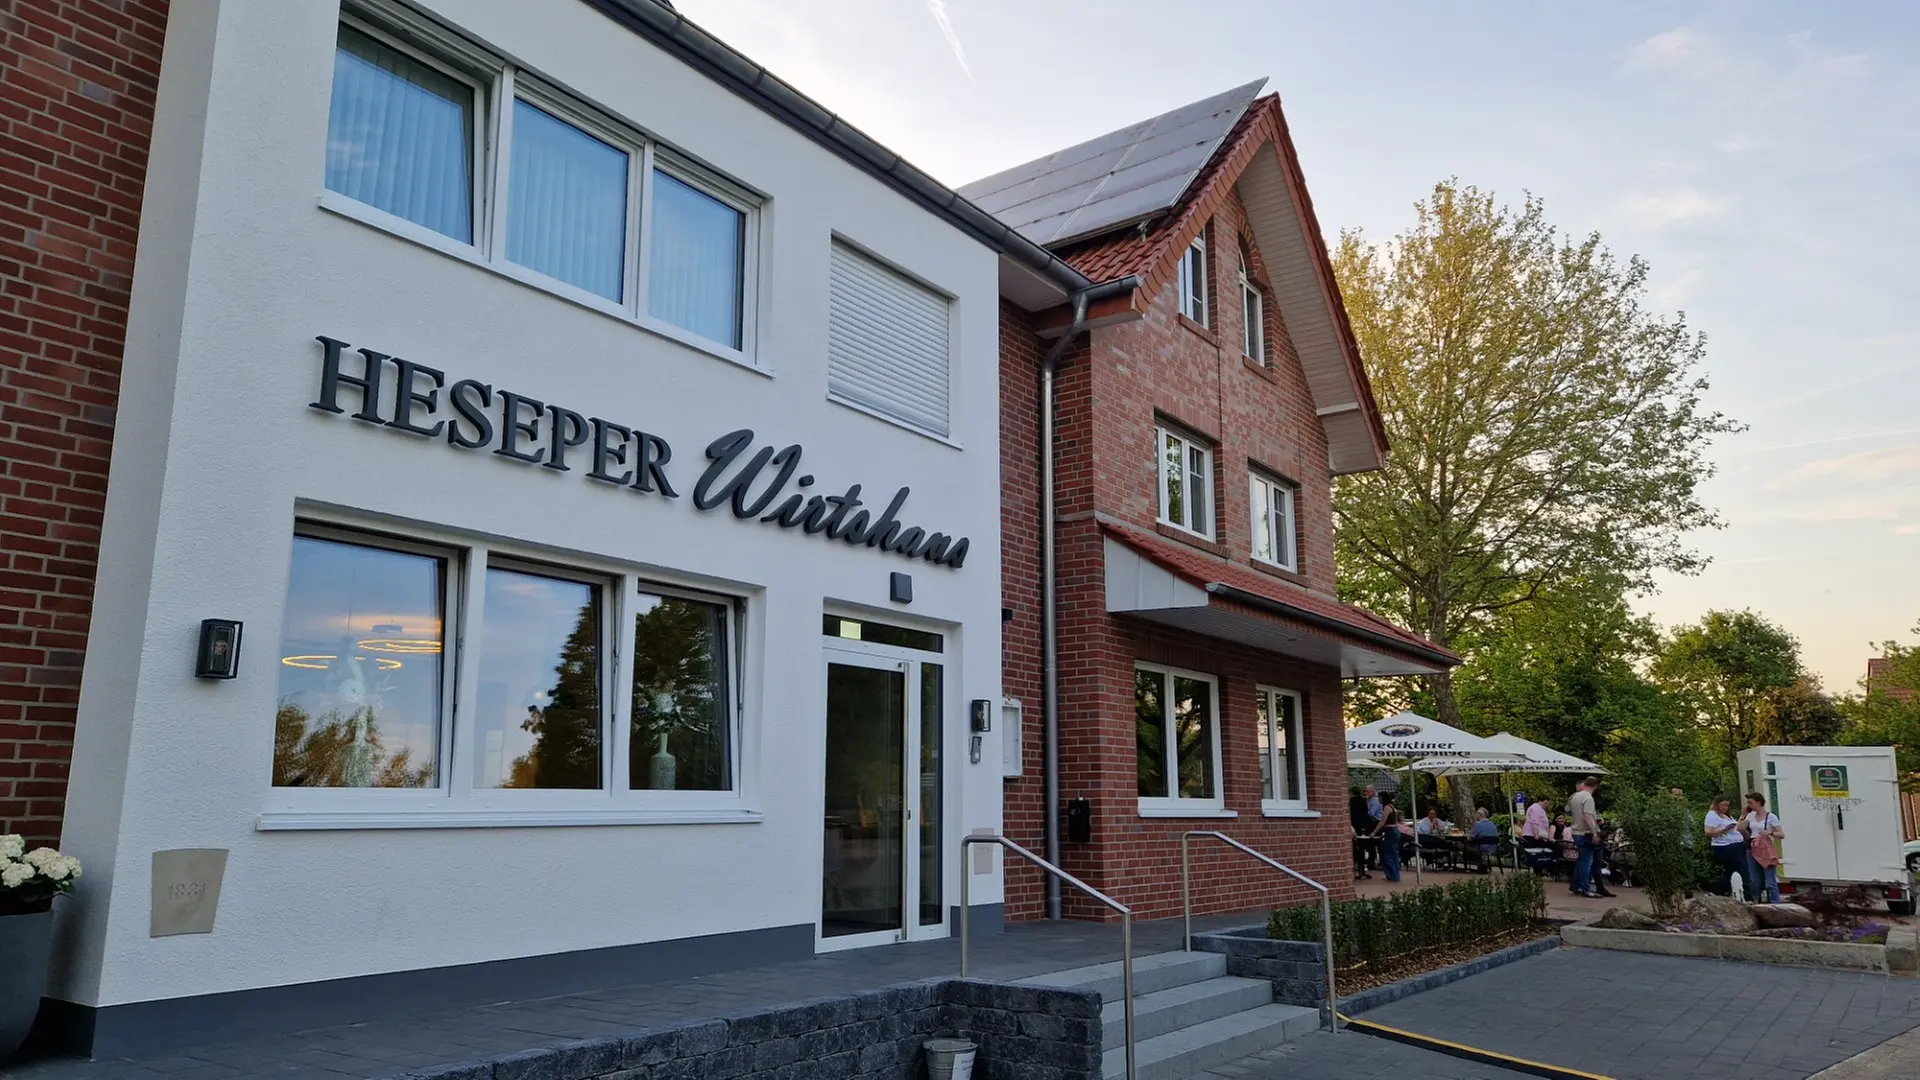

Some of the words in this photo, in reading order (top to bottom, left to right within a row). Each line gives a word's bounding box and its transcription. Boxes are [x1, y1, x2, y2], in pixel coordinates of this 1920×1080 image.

[309, 335, 679, 499] HESEPER
[692, 428, 970, 568] Wirtshaus
[1346, 740, 1455, 751] Benediktiner
[1811, 802, 1852, 812] SERVICE
